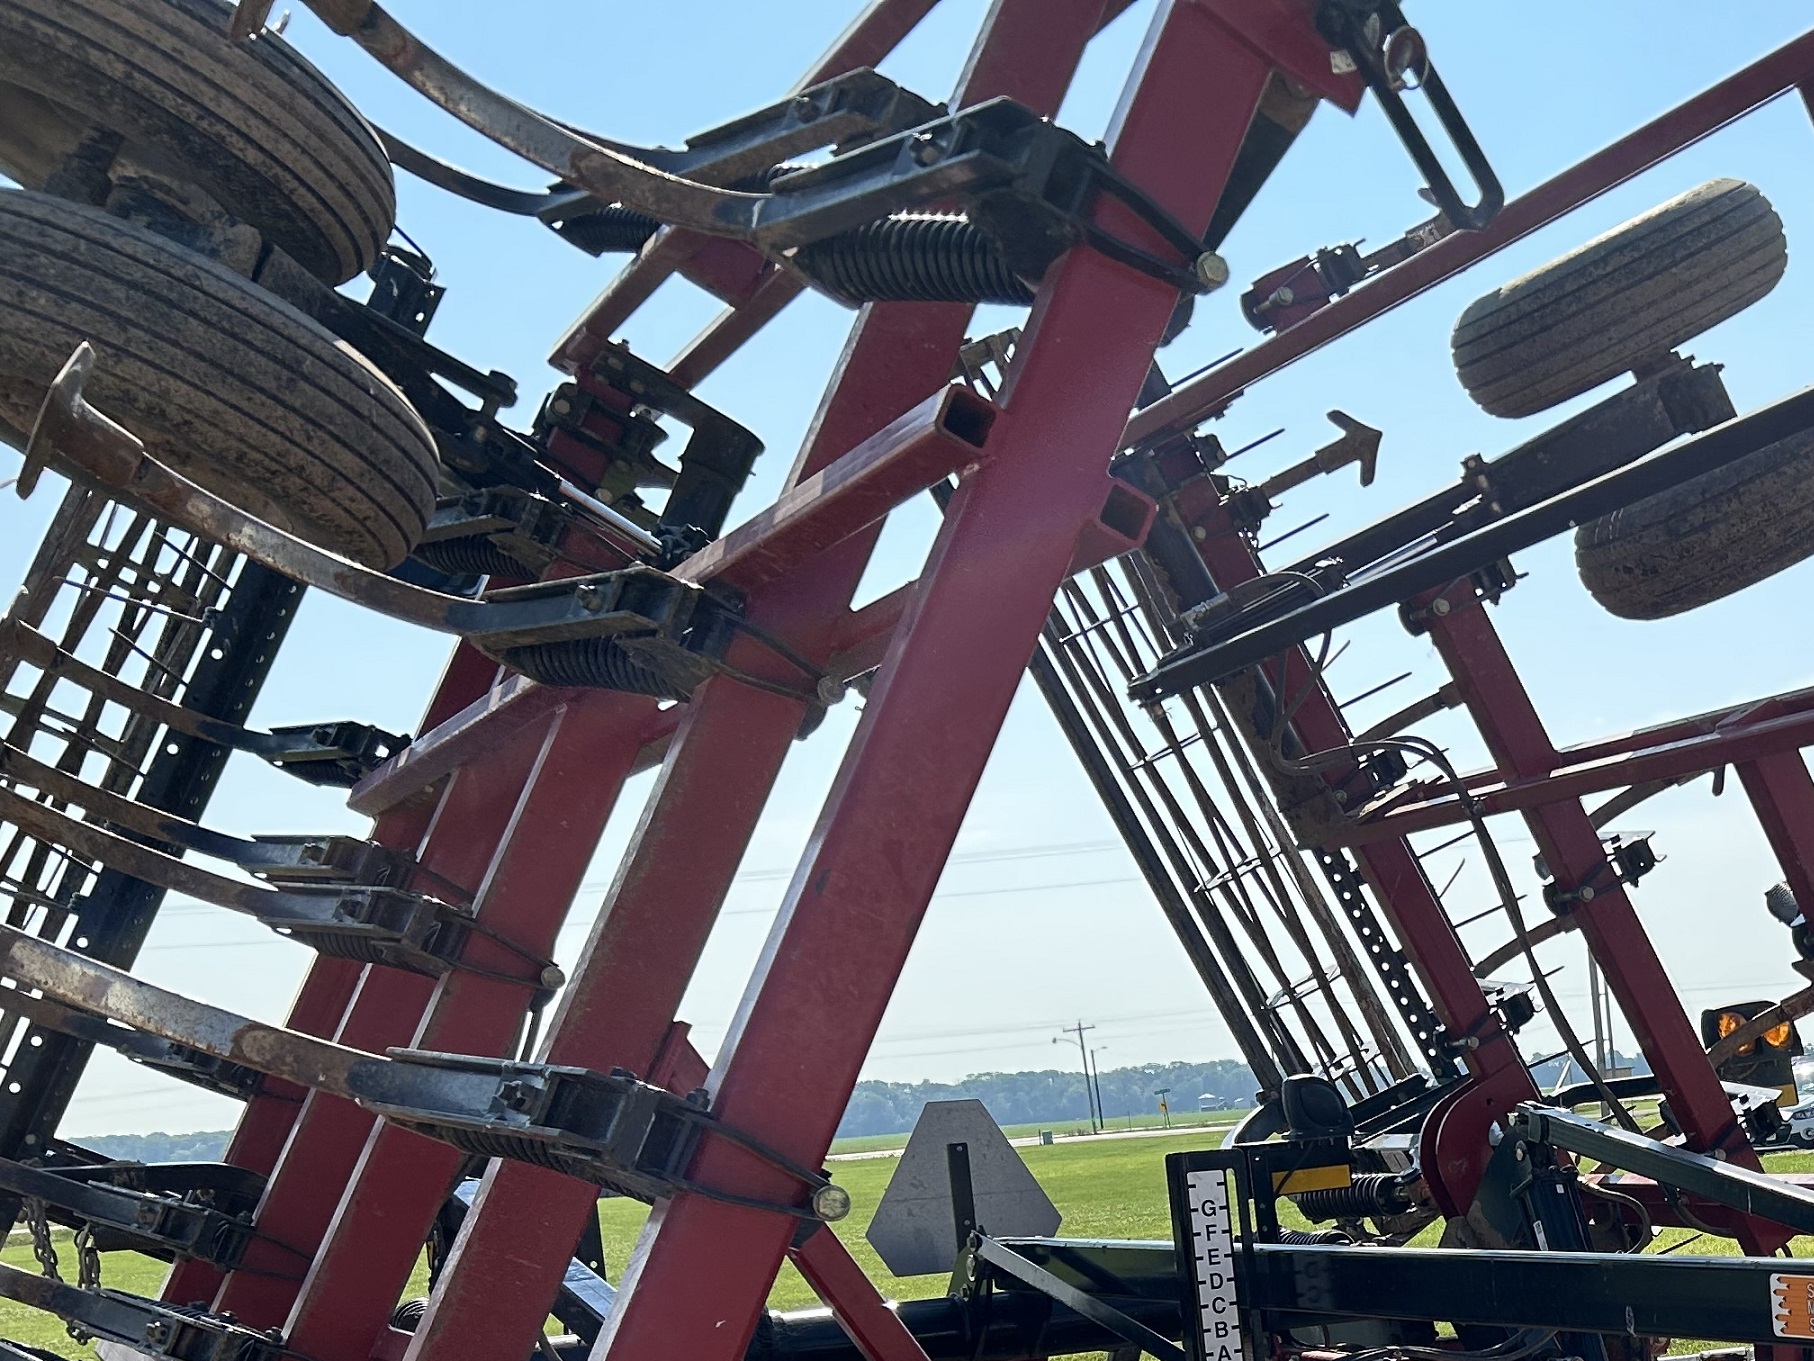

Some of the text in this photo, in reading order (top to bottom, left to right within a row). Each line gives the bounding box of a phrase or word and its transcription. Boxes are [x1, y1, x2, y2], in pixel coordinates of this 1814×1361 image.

[1201, 1199, 1217, 1217] G
[1205, 1224, 1217, 1241] F
[1207, 1248, 1221, 1265] E
[1209, 1273, 1223, 1290] D
[1212, 1297, 1226, 1314] C
[1214, 1321, 1228, 1338] B
[1217, 1345, 1232, 1361] A
